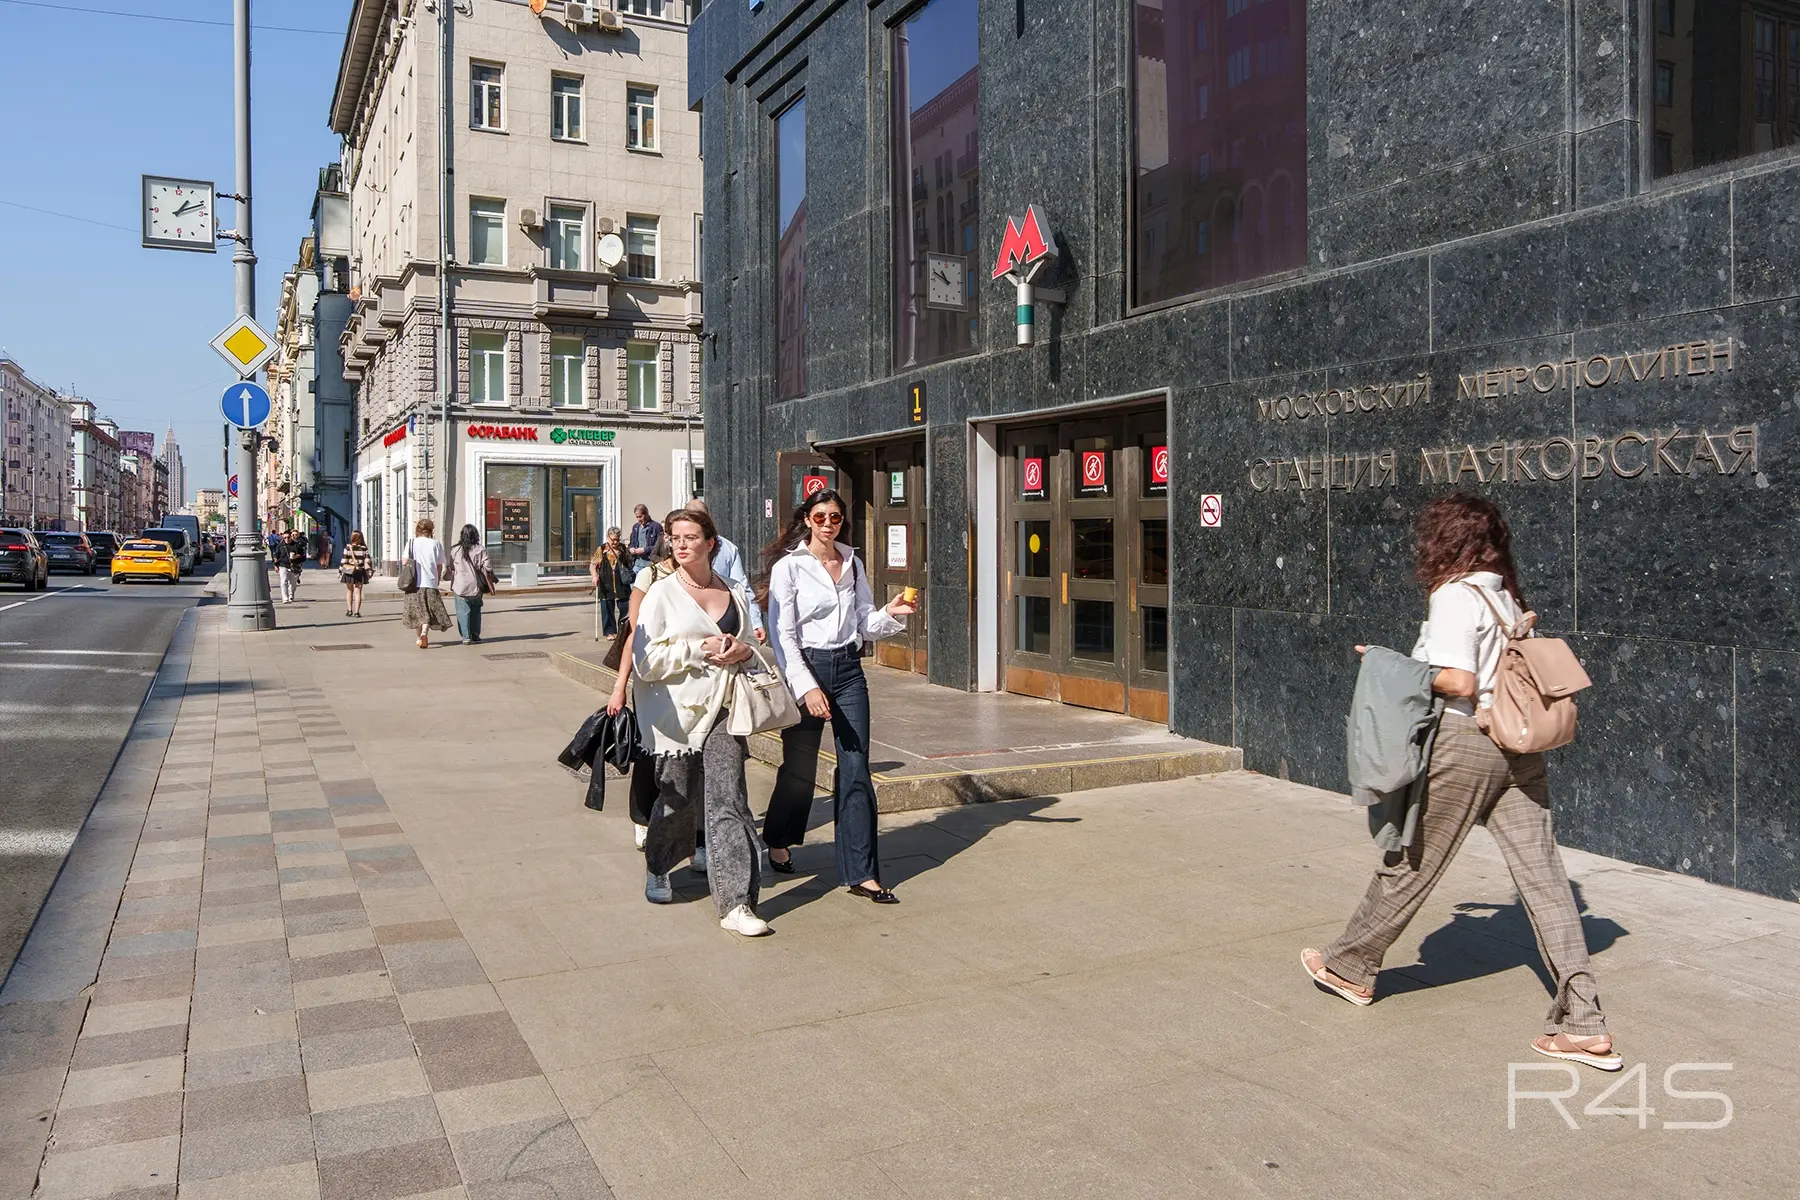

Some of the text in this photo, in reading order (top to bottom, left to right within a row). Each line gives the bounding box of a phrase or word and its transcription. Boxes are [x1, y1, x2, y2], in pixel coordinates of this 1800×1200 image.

[1257, 337, 1734, 422] МОСКОВСКИЙ МЕТРОПОЛИТЕН
[913, 387, 922, 414] 1
[467, 424, 538, 441] ФОРАБАНК
[568, 429, 617, 441] КЛЕВЕР
[1250, 424, 1759, 493] СТАНЦИЯ МАЯКОВСКАЯ
